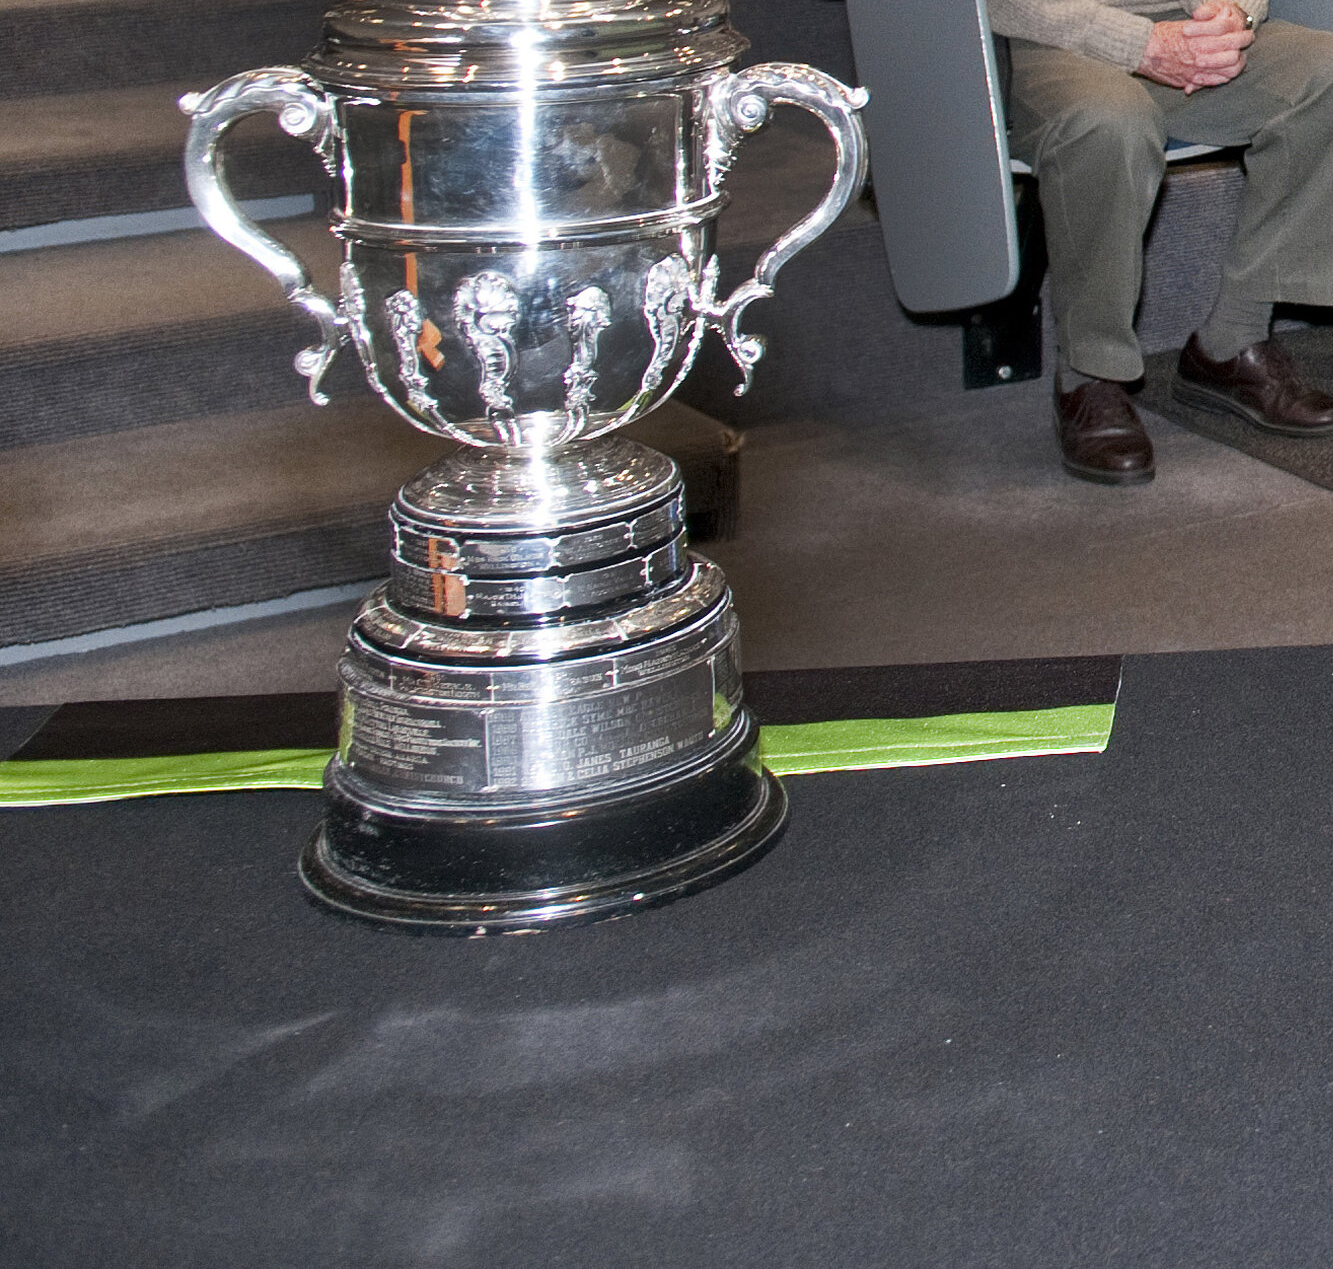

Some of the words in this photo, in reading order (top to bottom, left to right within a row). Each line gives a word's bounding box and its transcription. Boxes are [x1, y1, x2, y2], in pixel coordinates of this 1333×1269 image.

[576, 753, 612, 768] JAMES
[619, 735, 671, 759] TAURANGA
[576, 765, 610, 779] CELIA
[612, 743, 675, 771] STEPHENSON
